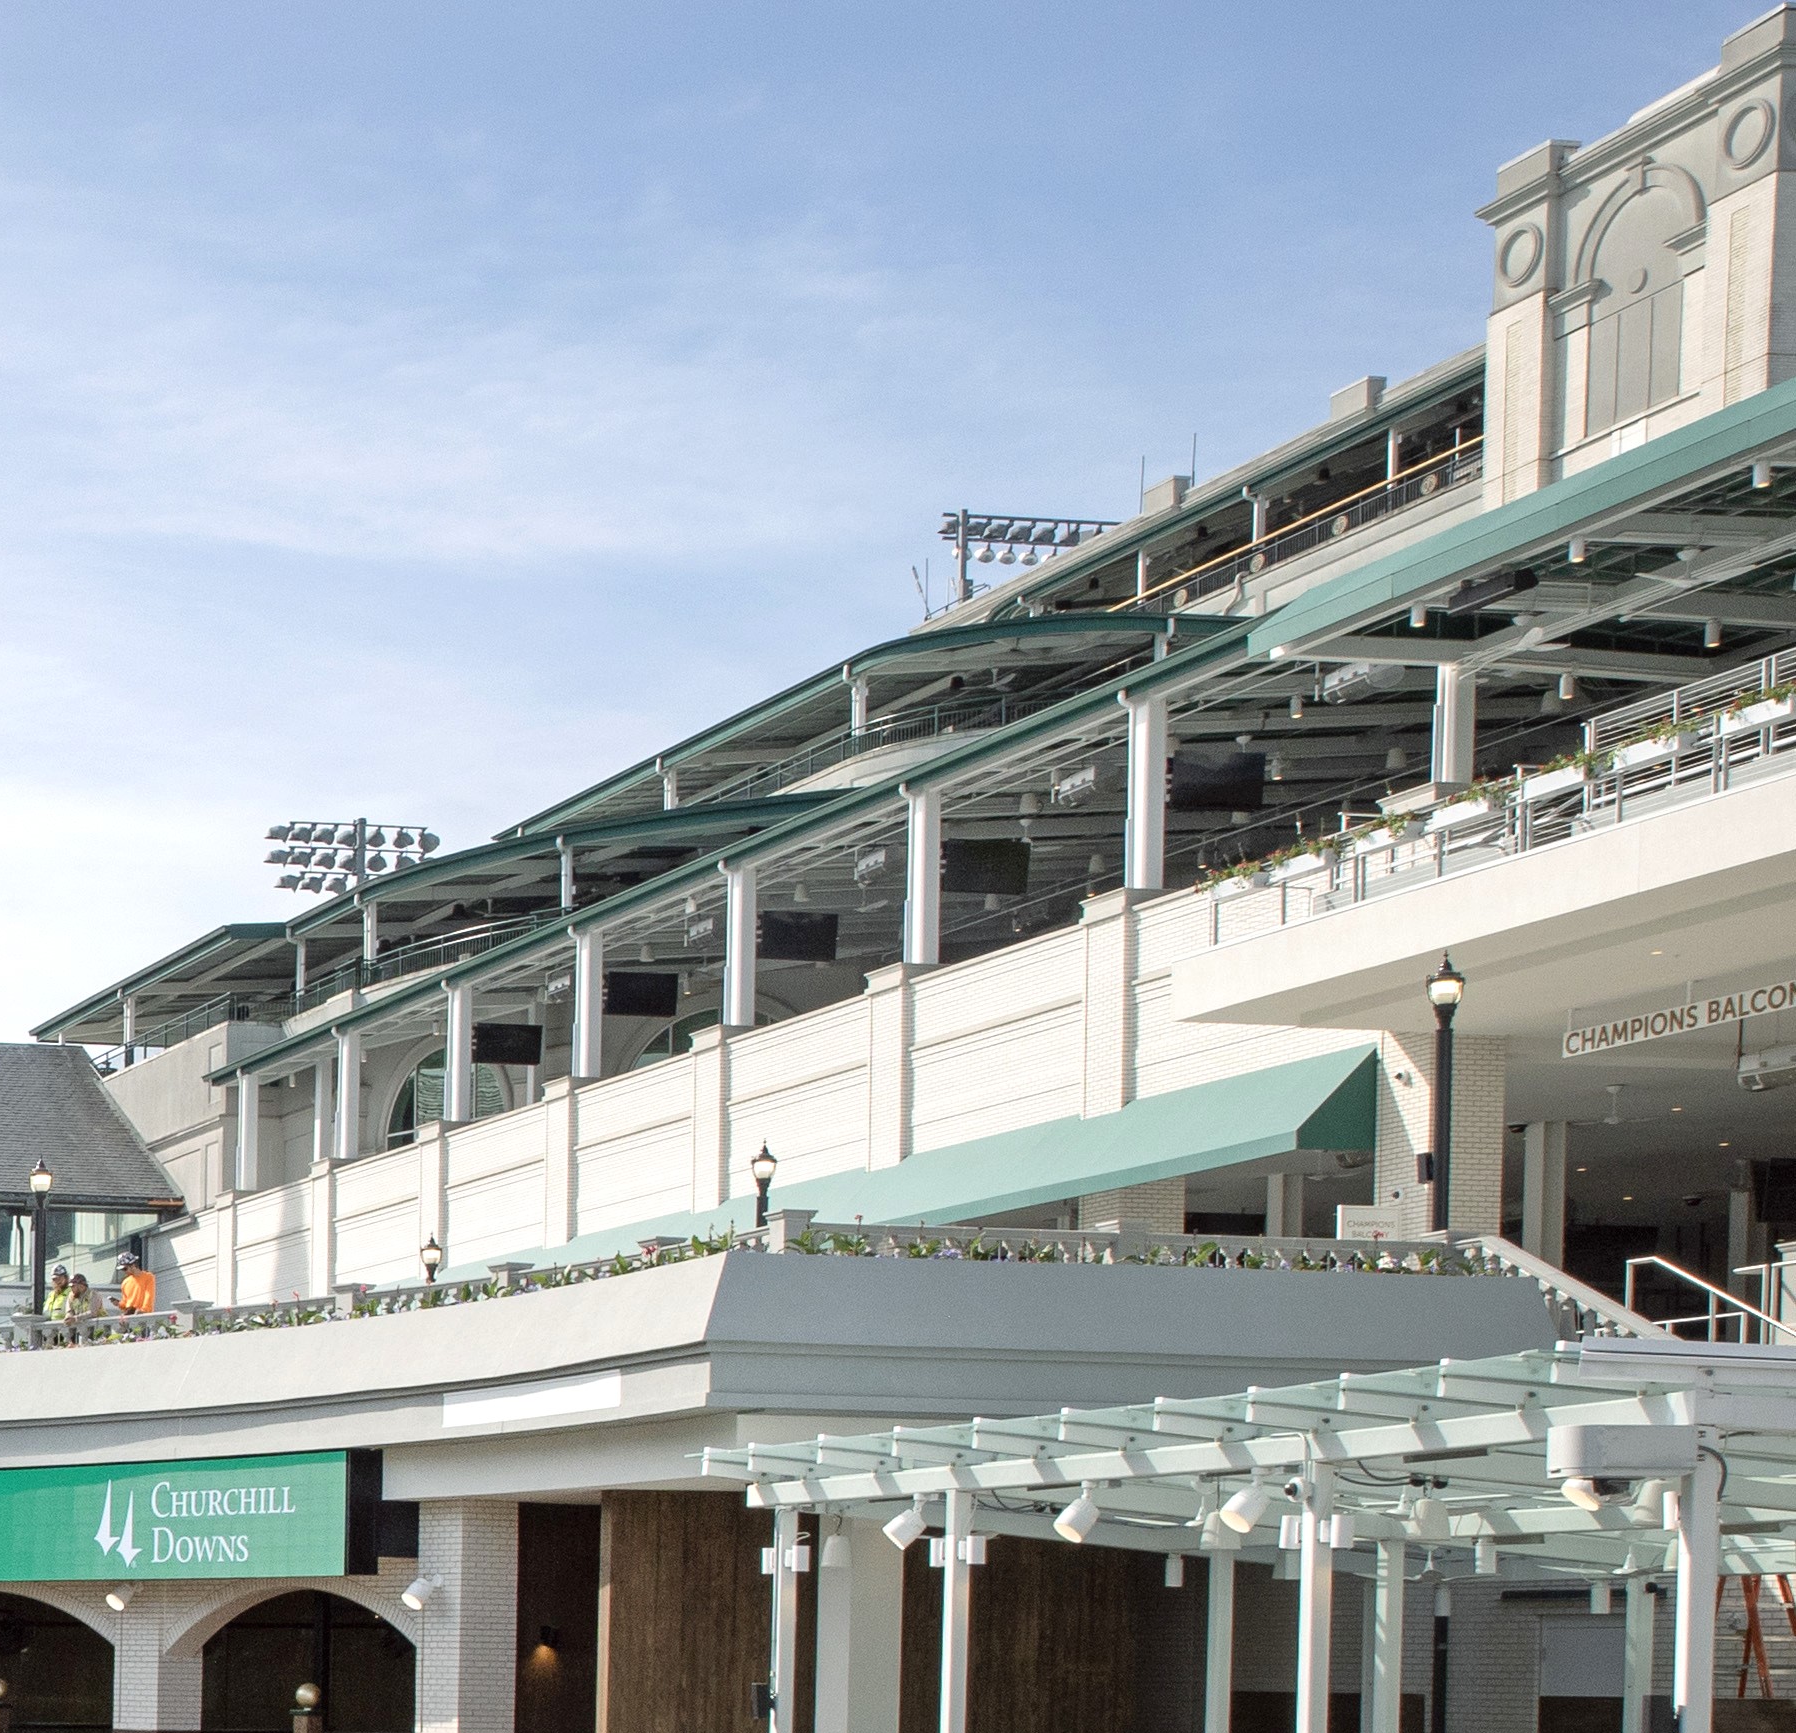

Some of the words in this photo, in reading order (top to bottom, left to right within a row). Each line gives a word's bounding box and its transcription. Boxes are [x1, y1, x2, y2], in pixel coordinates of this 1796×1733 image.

[1565, 1004, 1698, 1055] CHAMPIONS
[151, 1481, 296, 1518] CHURCHILL
[153, 1527, 249, 1563] DOWNS
